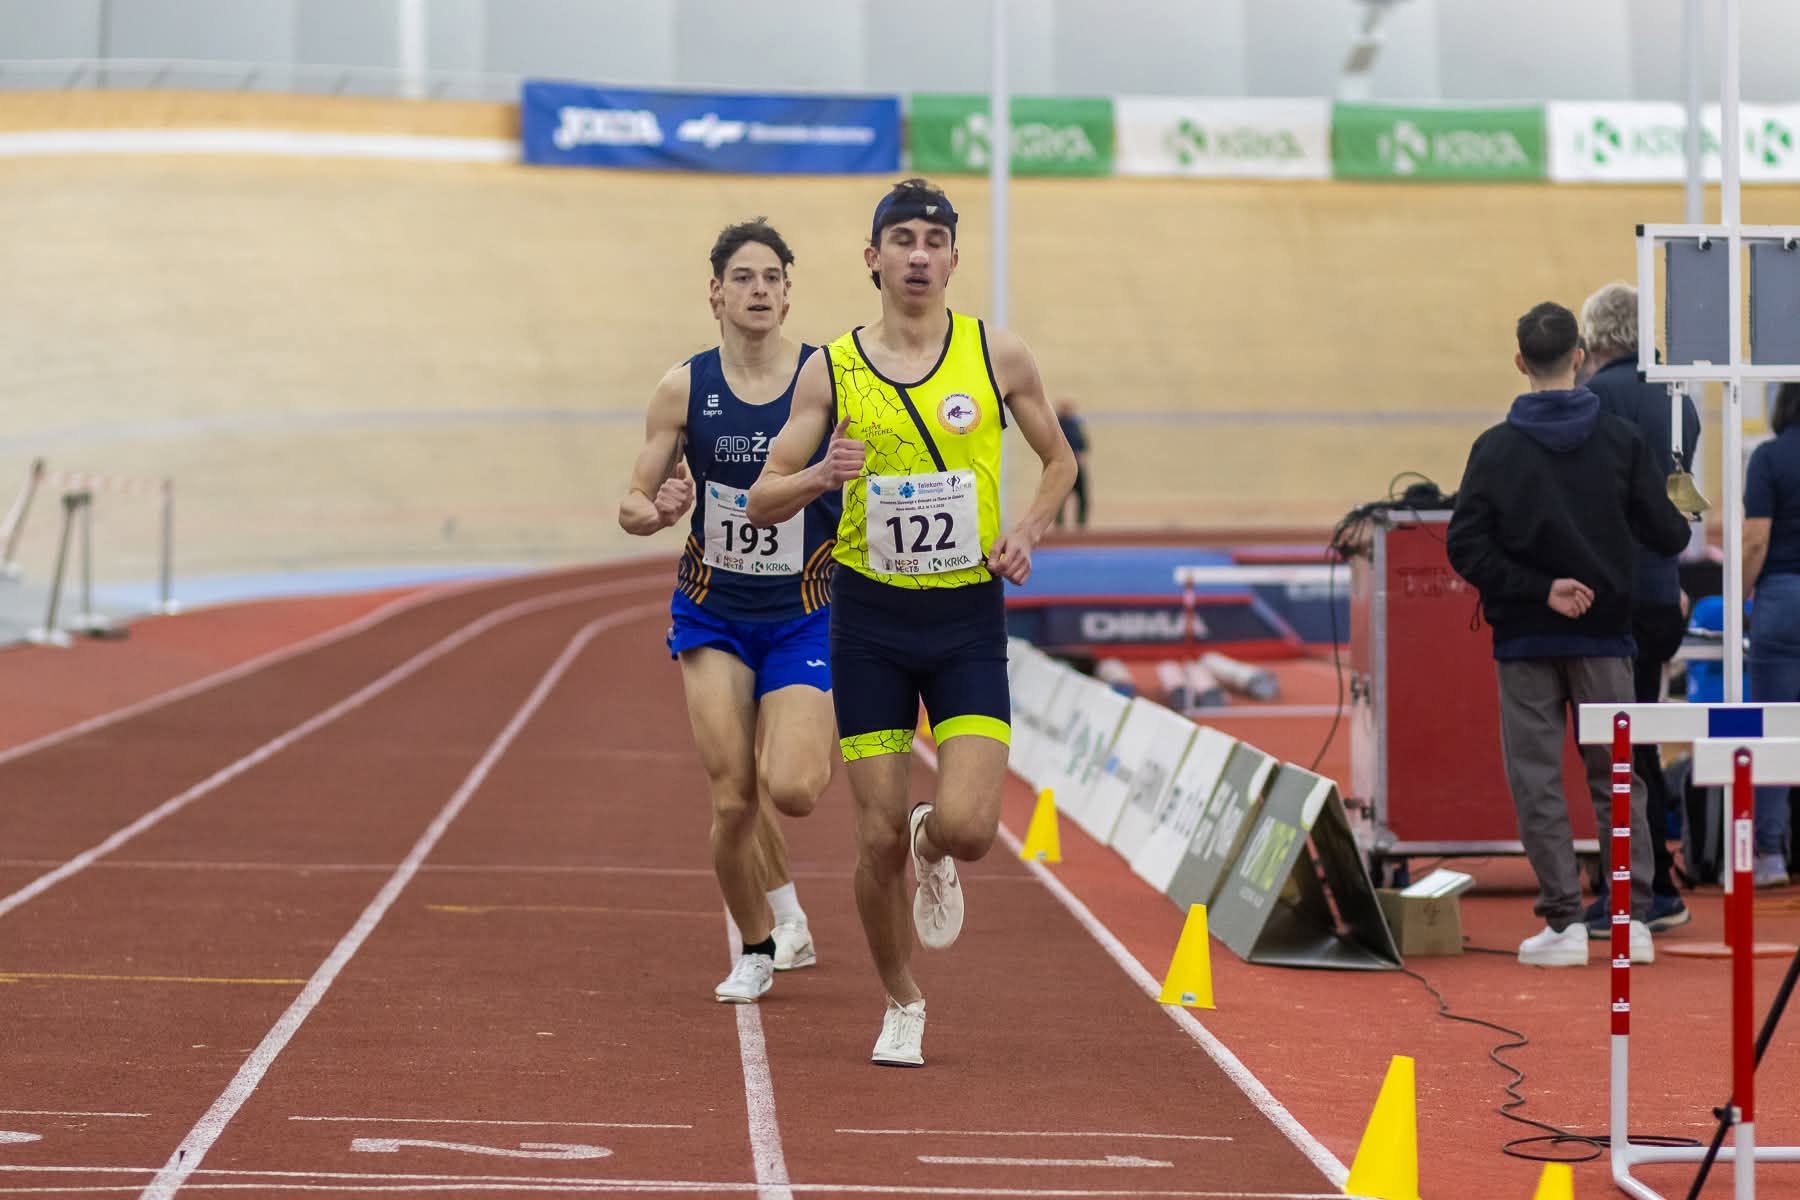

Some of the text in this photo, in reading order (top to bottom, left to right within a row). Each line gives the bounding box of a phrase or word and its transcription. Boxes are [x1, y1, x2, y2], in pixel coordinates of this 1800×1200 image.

[703, 409, 723, 418] tapro
[721, 520, 778, 556] 193
[886, 512, 956, 553] 122
[765, 562, 792, 572] KRKA
[944, 555, 972, 568] KRKA
